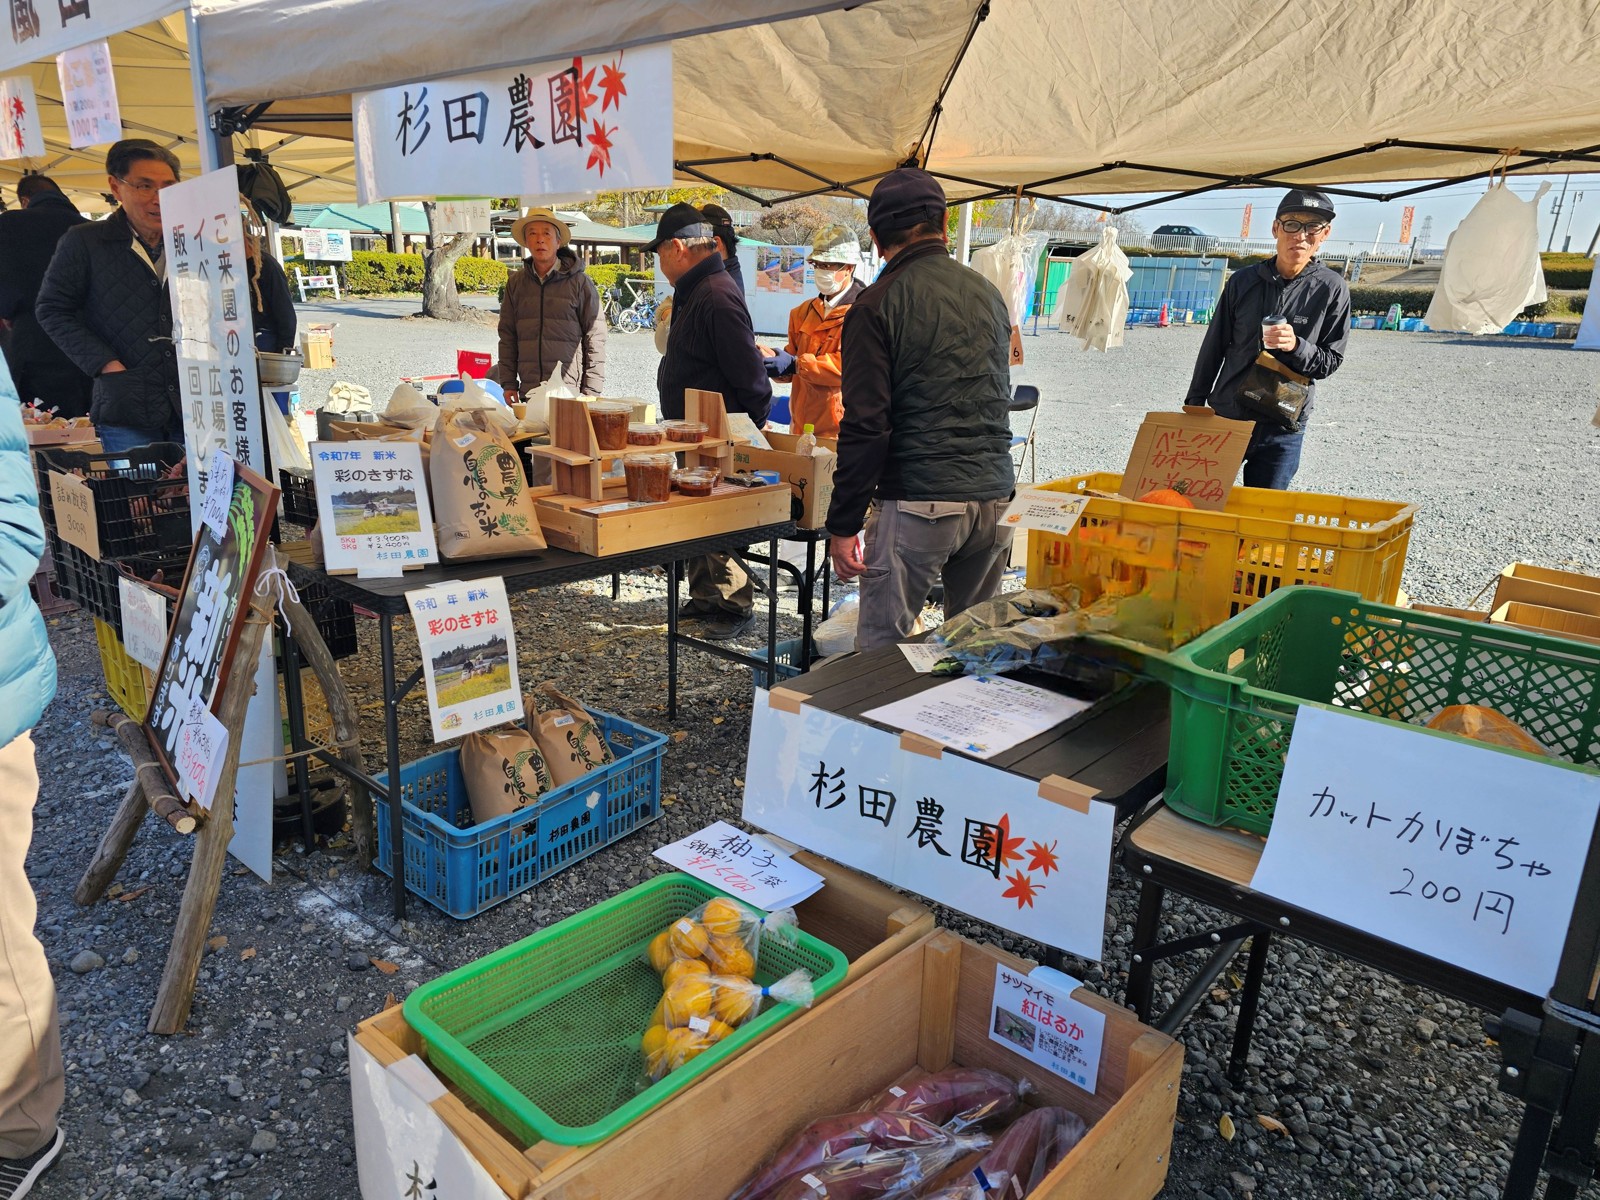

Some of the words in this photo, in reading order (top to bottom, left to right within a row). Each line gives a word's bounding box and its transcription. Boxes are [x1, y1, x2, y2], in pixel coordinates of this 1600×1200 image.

[395, 66, 583, 157] 杉田農園
[318, 451, 361, 461] 令和7年
[373, 450, 397, 460] 新米
[1156, 429, 1232, 454] ベニクリ
[334, 468, 414, 483] 彩のきずな
[496, 450, 519, 507] 農家
[1151, 450, 1219, 477] カボチャ
[463, 449, 501, 539] 自慢のお米
[376, 548, 429, 560] 杉田農園
[414, 597, 438, 611] 令和
[446, 594, 458, 606] 年
[467, 588, 489, 602] 新米
[427, 608, 500, 636] 彩のきずな
[473, 700, 516, 721] 杉田農園
[548, 810, 591, 843] 杉田農園
[808, 760, 1005, 880] 杉田農園
[1309, 786, 1552, 877] カットかぼちゃ
[718, 834, 778, 869] 柚子
[1389, 867, 1515, 935] 200円
[1001, 972, 1055, 1006] サツマイモ
[1021, 998, 1085, 1041] 紅はるか
